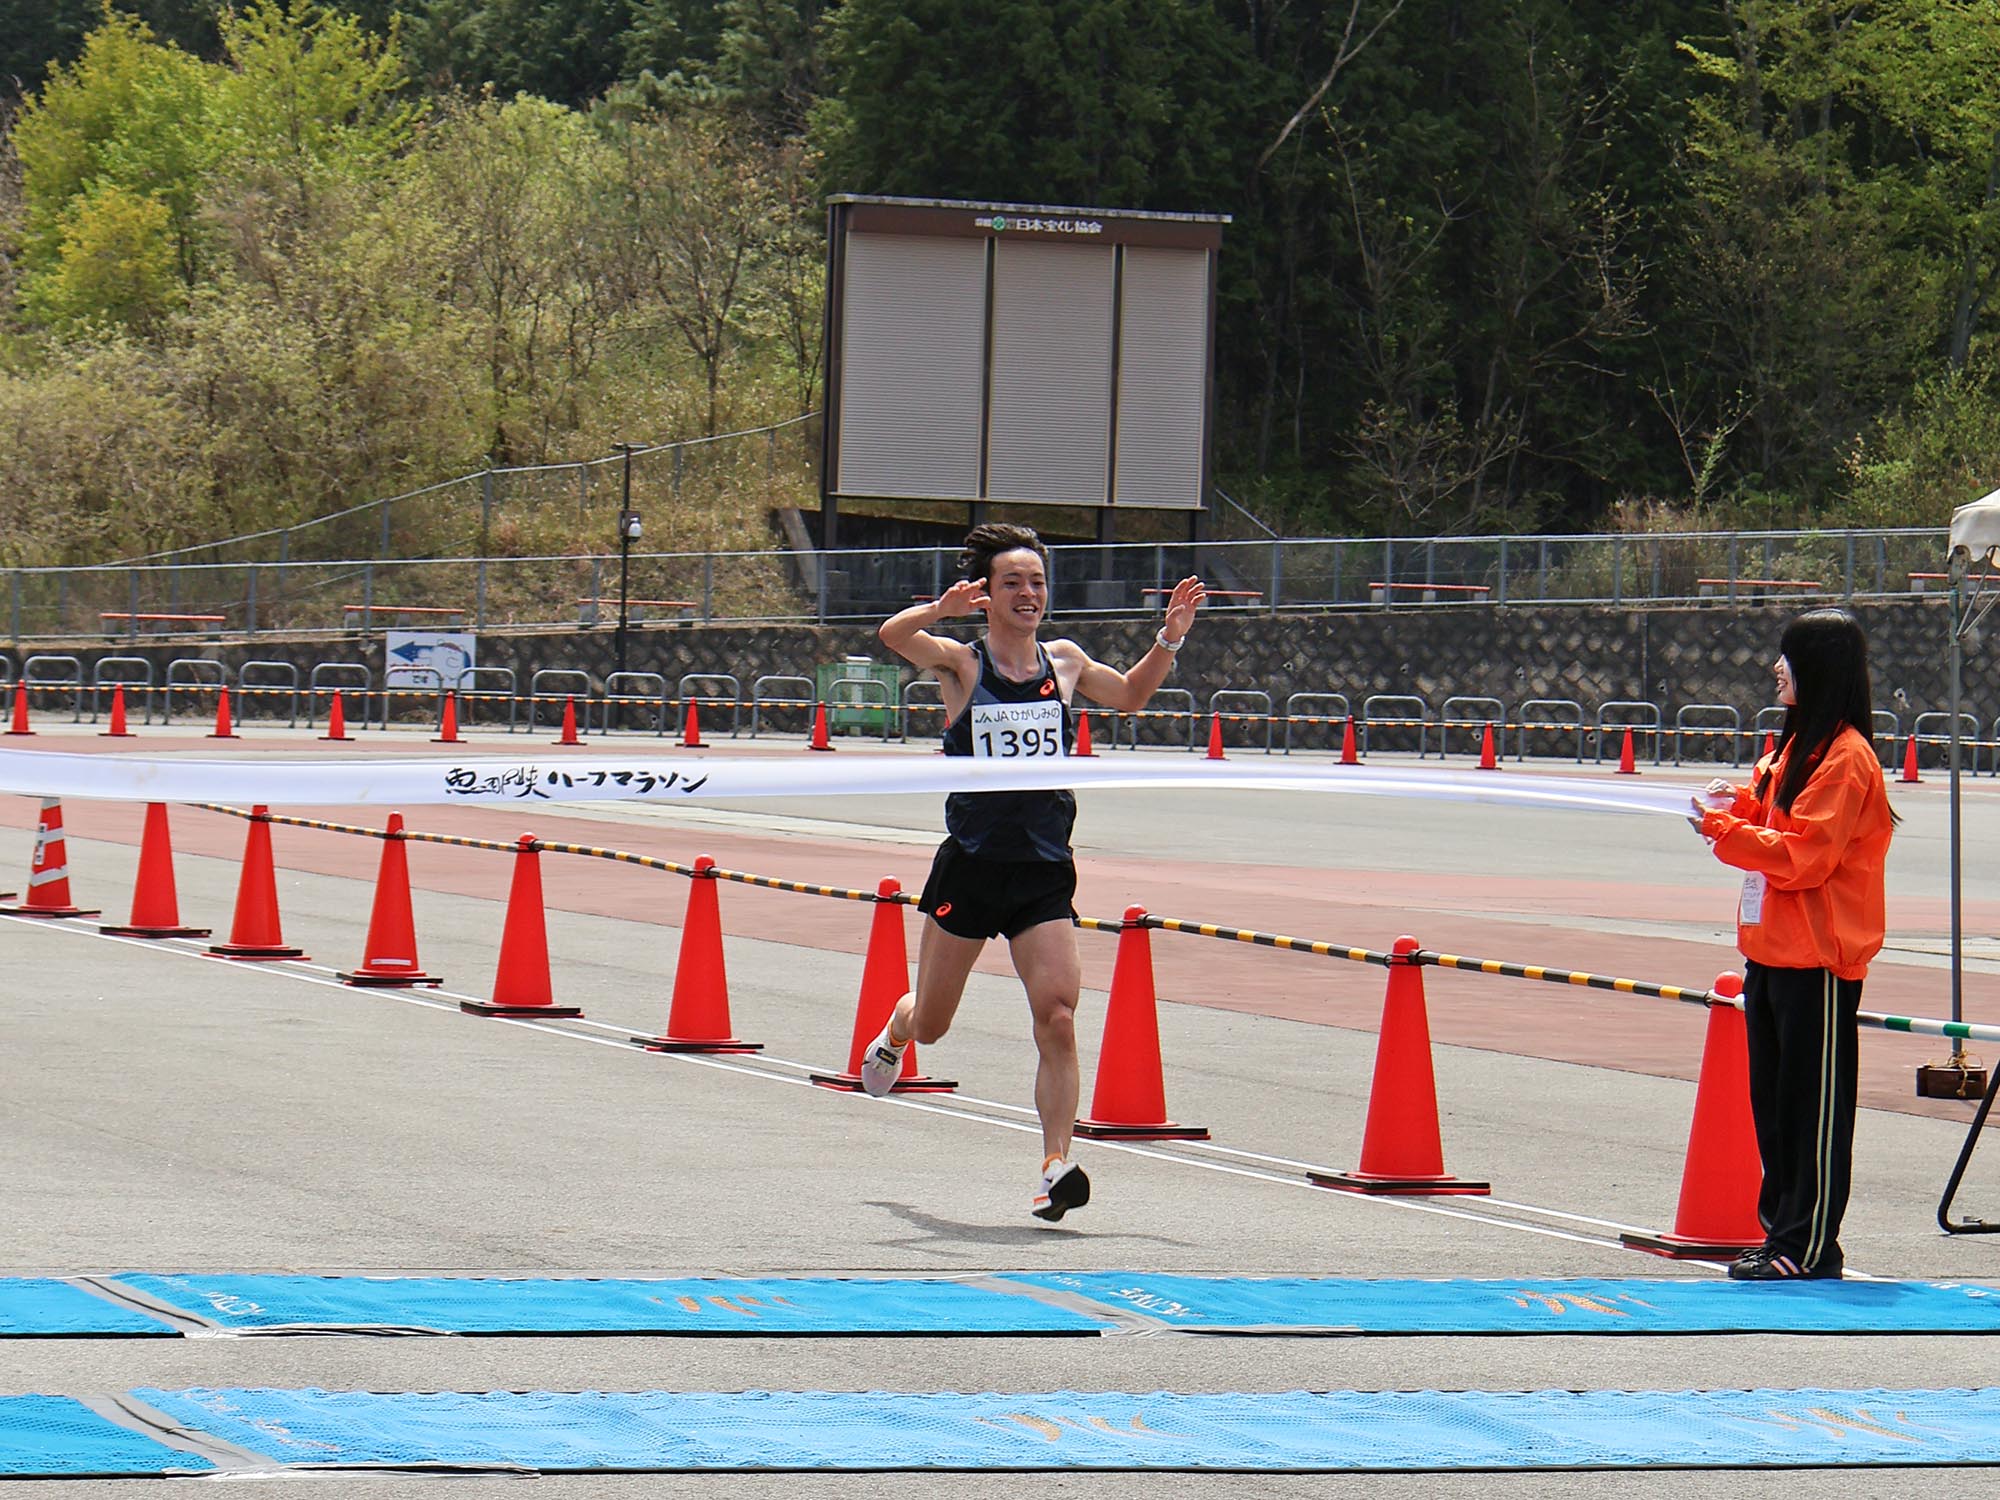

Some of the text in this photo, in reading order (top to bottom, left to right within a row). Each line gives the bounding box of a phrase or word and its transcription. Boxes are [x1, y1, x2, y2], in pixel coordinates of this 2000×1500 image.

[994, 707, 1061, 723] JAひがしみの
[979, 728, 1059, 757] 1395
